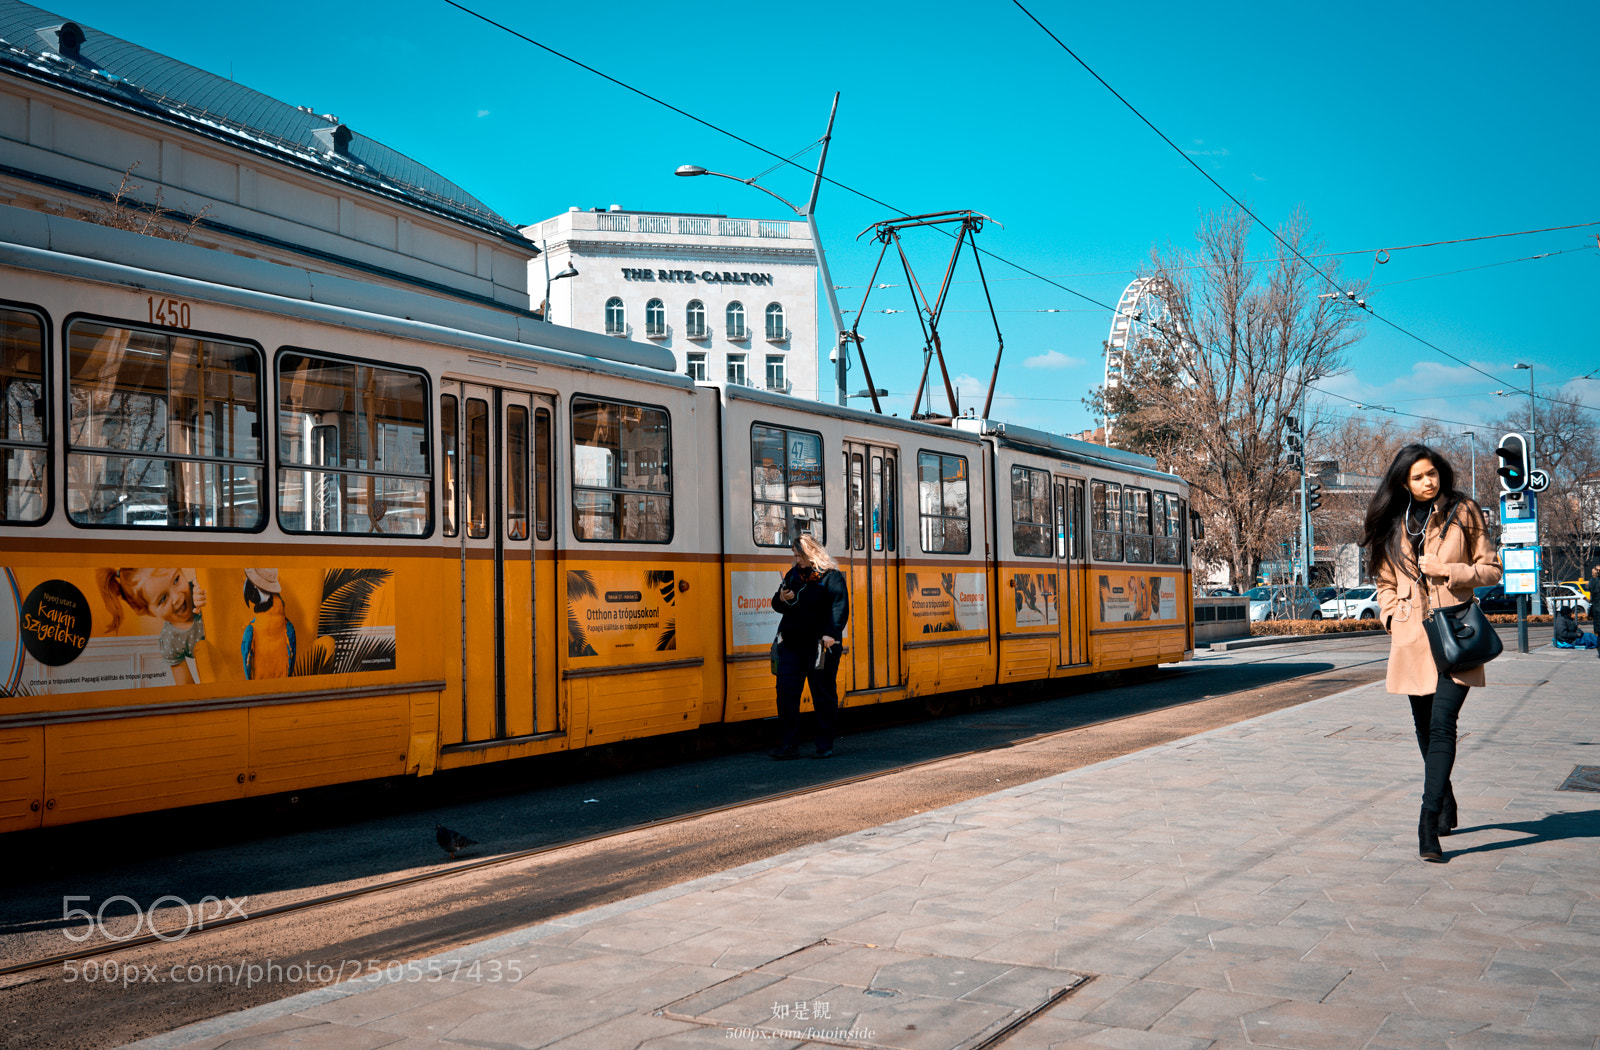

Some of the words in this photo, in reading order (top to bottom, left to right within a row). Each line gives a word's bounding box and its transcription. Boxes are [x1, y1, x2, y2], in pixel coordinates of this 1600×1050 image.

[621, 268, 653, 281] THE
[148, 296, 191, 329] 1450
[791, 441, 804, 459] 47
[737, 595, 772, 611] Campon
[960, 592, 985, 604] Campona
[586, 608, 612, 620] Otthon
[613, 610, 617, 619] a
[618, 607, 659, 620] trópusokon!
[22, 613, 86, 649] Szigetekre
